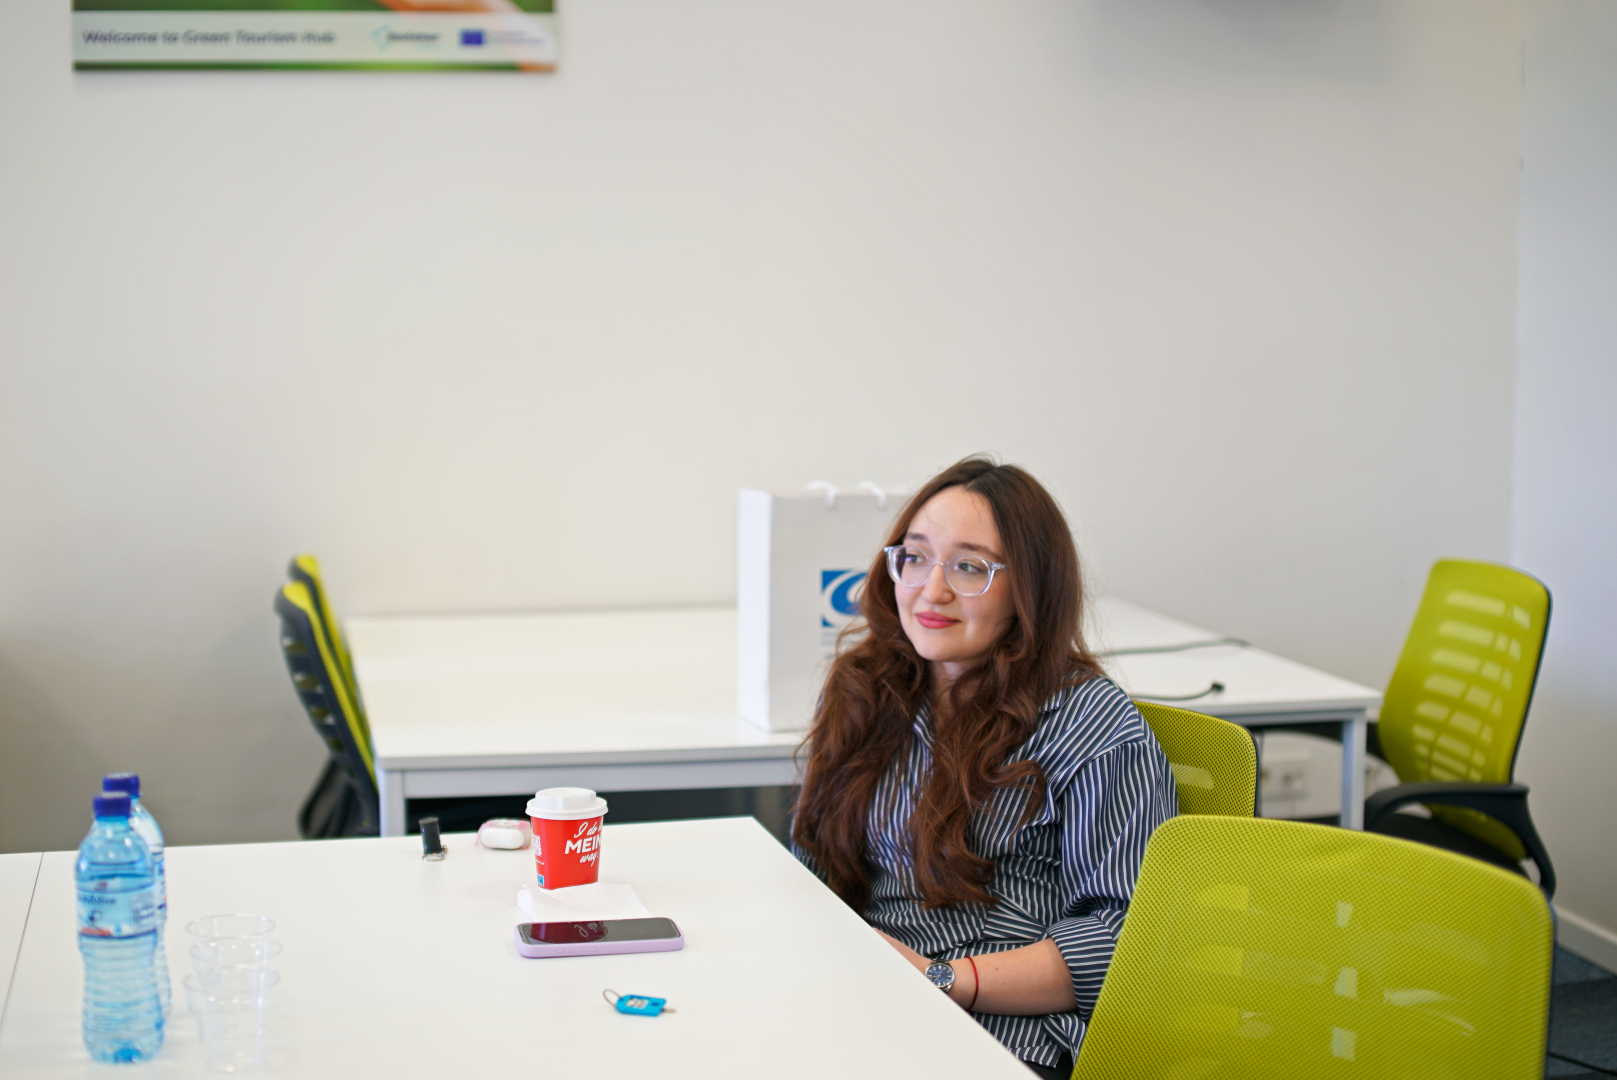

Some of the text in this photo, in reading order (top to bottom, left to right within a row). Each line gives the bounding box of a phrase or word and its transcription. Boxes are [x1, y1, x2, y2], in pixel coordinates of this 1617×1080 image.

[82, 29, 337, 45] Welcome to Green Tourism Hub
[564, 834, 601, 854] MEIN
